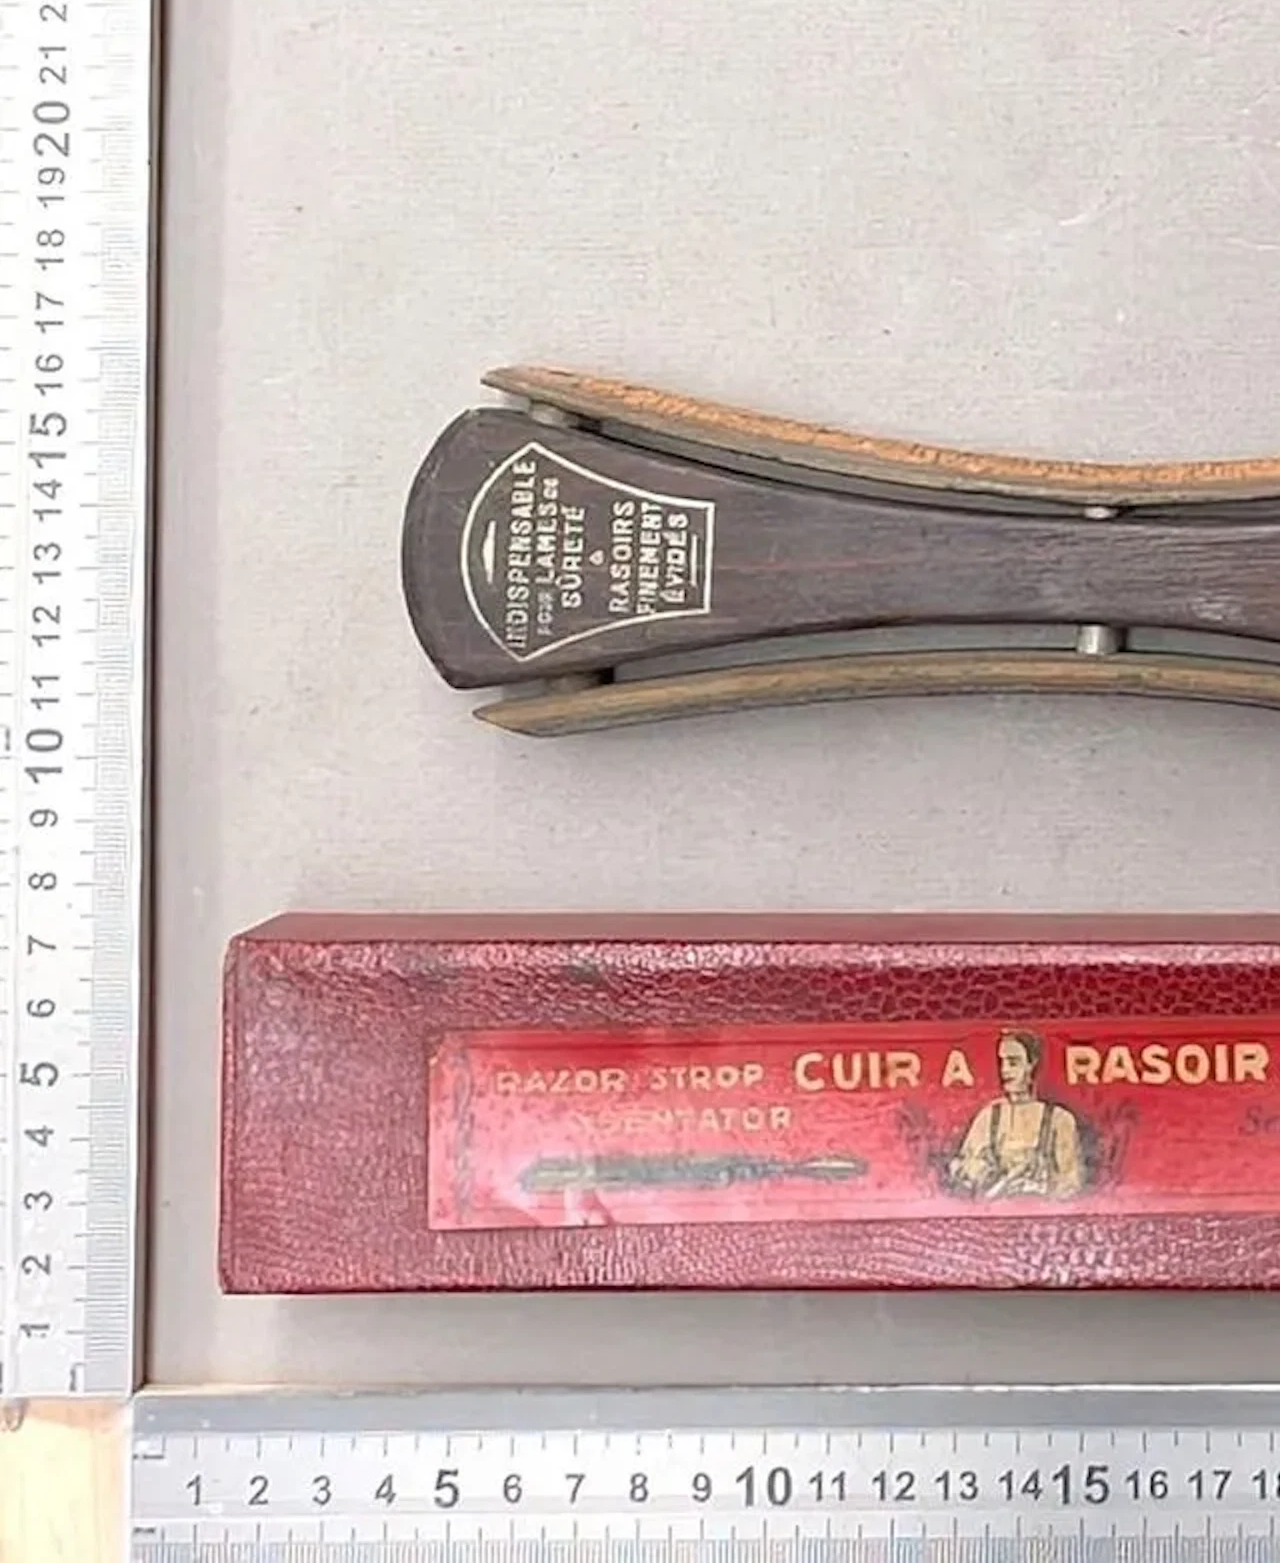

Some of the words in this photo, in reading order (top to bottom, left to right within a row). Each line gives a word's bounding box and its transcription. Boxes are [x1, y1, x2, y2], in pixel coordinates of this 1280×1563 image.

[38, 46, 66, 84] 21
[32, 100, 70, 157] 20
[36, 167, 65, 208] 19
[34, 228, 65, 270] 18
[34, 291, 64, 333] 17
[34, 353, 63, 396] 16
[27, 412, 66, 469] 15
[32, 478, 62, 521] 14
[31, 541, 61, 584] 13
[505, 460, 537, 649] INDISPENSABLE
[535, 502, 558, 585] LAMES
[608, 499, 636, 613] RASOIRS
[636, 501, 662, 615] FINEMENT
[31, 605, 60, 647] 12
[30, 675, 59, 710] 11
[24, 728, 63, 784] 10
[28, 808, 58, 827] 9
[27, 872, 56, 890] 8
[27, 934, 56, 955] 7
[26, 998, 55, 1018] 6
[19, 1061, 58, 1086] 5
[496, 1066, 627, 1095] RAZOR
[650, 1063, 765, 1092] STROP
[795, 1050, 922, 1091] CUIR
[942, 1049, 976, 1089] A
[1065, 1041, 1270, 1087] RASOIR
[23, 1125, 54, 1147] 4
[23, 1190, 52, 1210] 3
[20, 1254, 51, 1275] 2
[18, 1323, 50, 1338] 1
[186, 1474, 200, 1506] 1
[248, 1475, 268, 1505] 2
[312, 1474, 331, 1506] 3
[374, 1474, 396, 1504] 4
[434, 1468, 459, 1508] 5
[503, 1473, 522, 1503] 6
[565, 1473, 585, 1503] 7
[629, 1472, 648, 1502] 8
[692, 1472, 711, 1502] 9
[735, 1465, 791, 1506] 10
[808, 1470, 845, 1501] 11
[872, 1470, 915, 1501] 12
[934, 1470, 978, 1501] 13
[998, 1469, 1042, 1500] 14
[1052, 1464, 1109, 1505] 15
[1126, 1469, 1168, 1499] 16
[1188, 1469, 1231, 1500] 17
